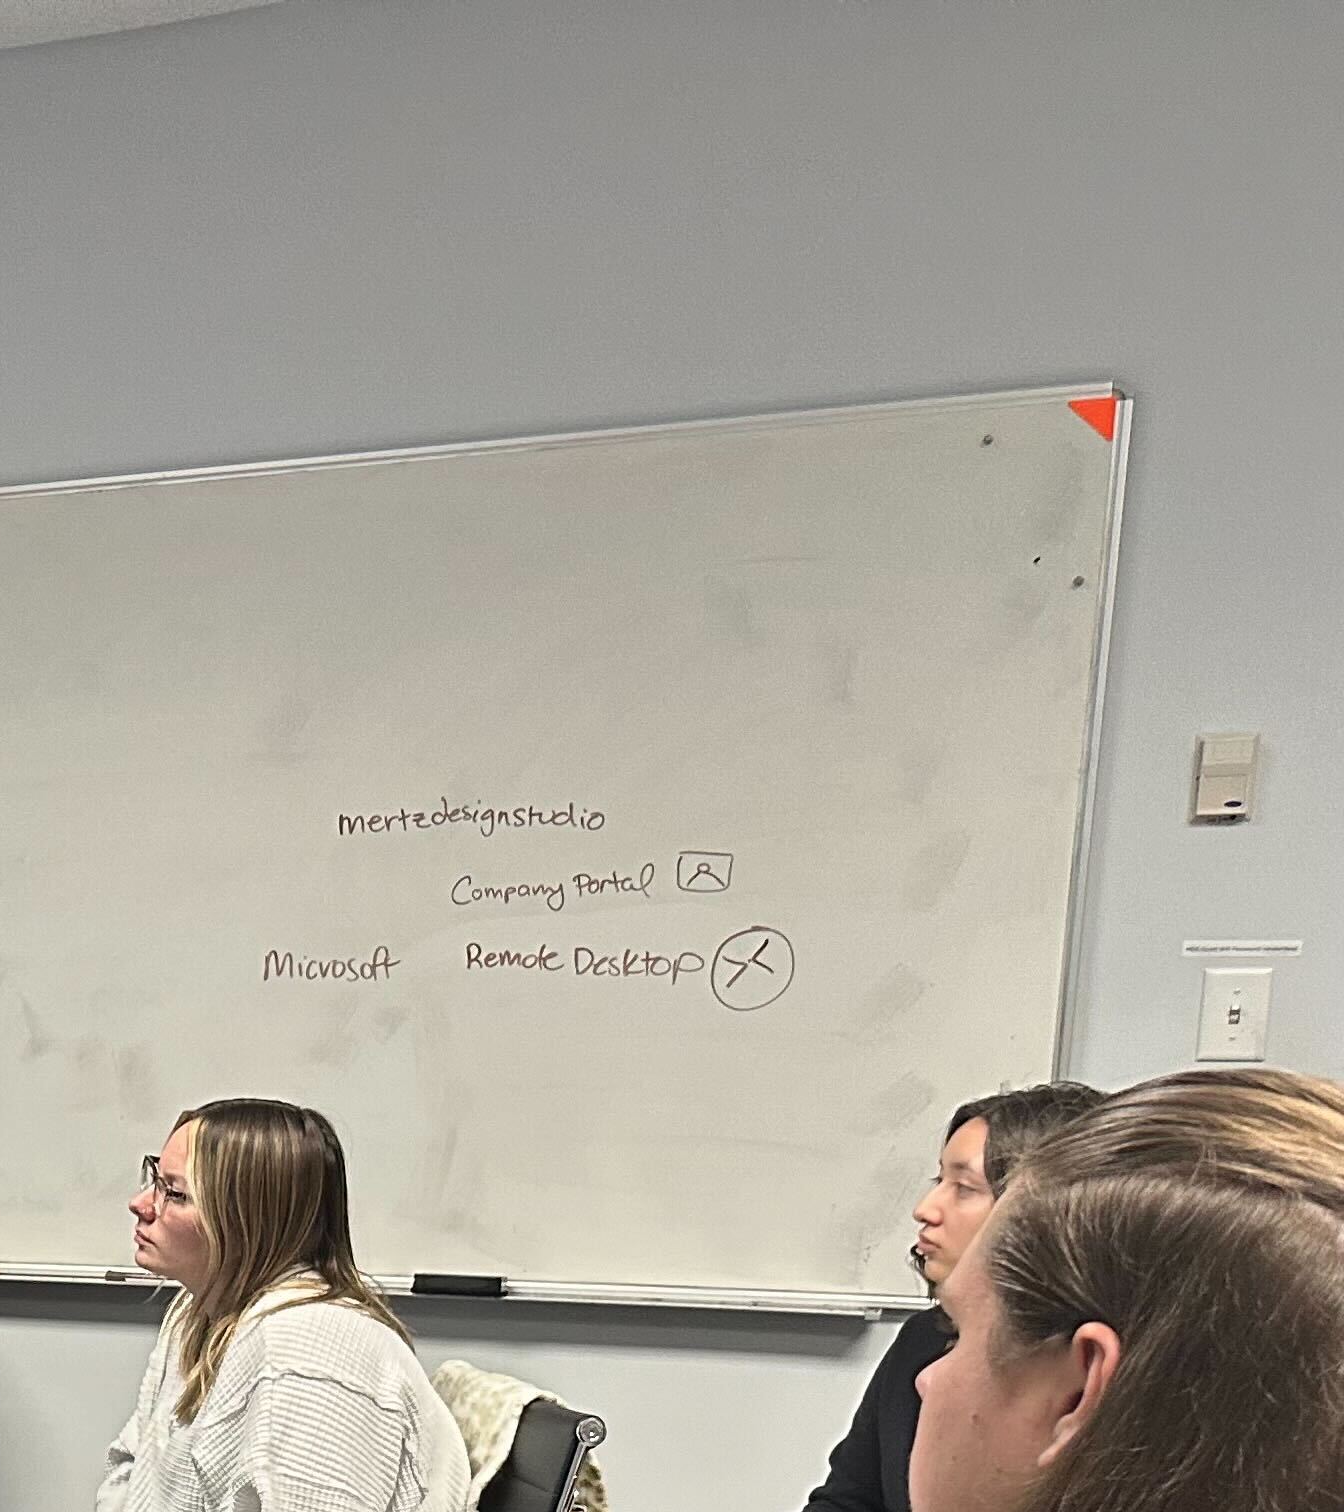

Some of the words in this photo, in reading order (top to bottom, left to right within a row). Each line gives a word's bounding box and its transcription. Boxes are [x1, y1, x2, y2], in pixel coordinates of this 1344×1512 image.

[337, 796, 606, 838] mertzdesignstudio
[572, 862, 656, 899] Portal
[263, 945, 402, 984] Microsoft
[465, 942, 565, 972] Remote
[573, 946, 706, 986] Desktop
